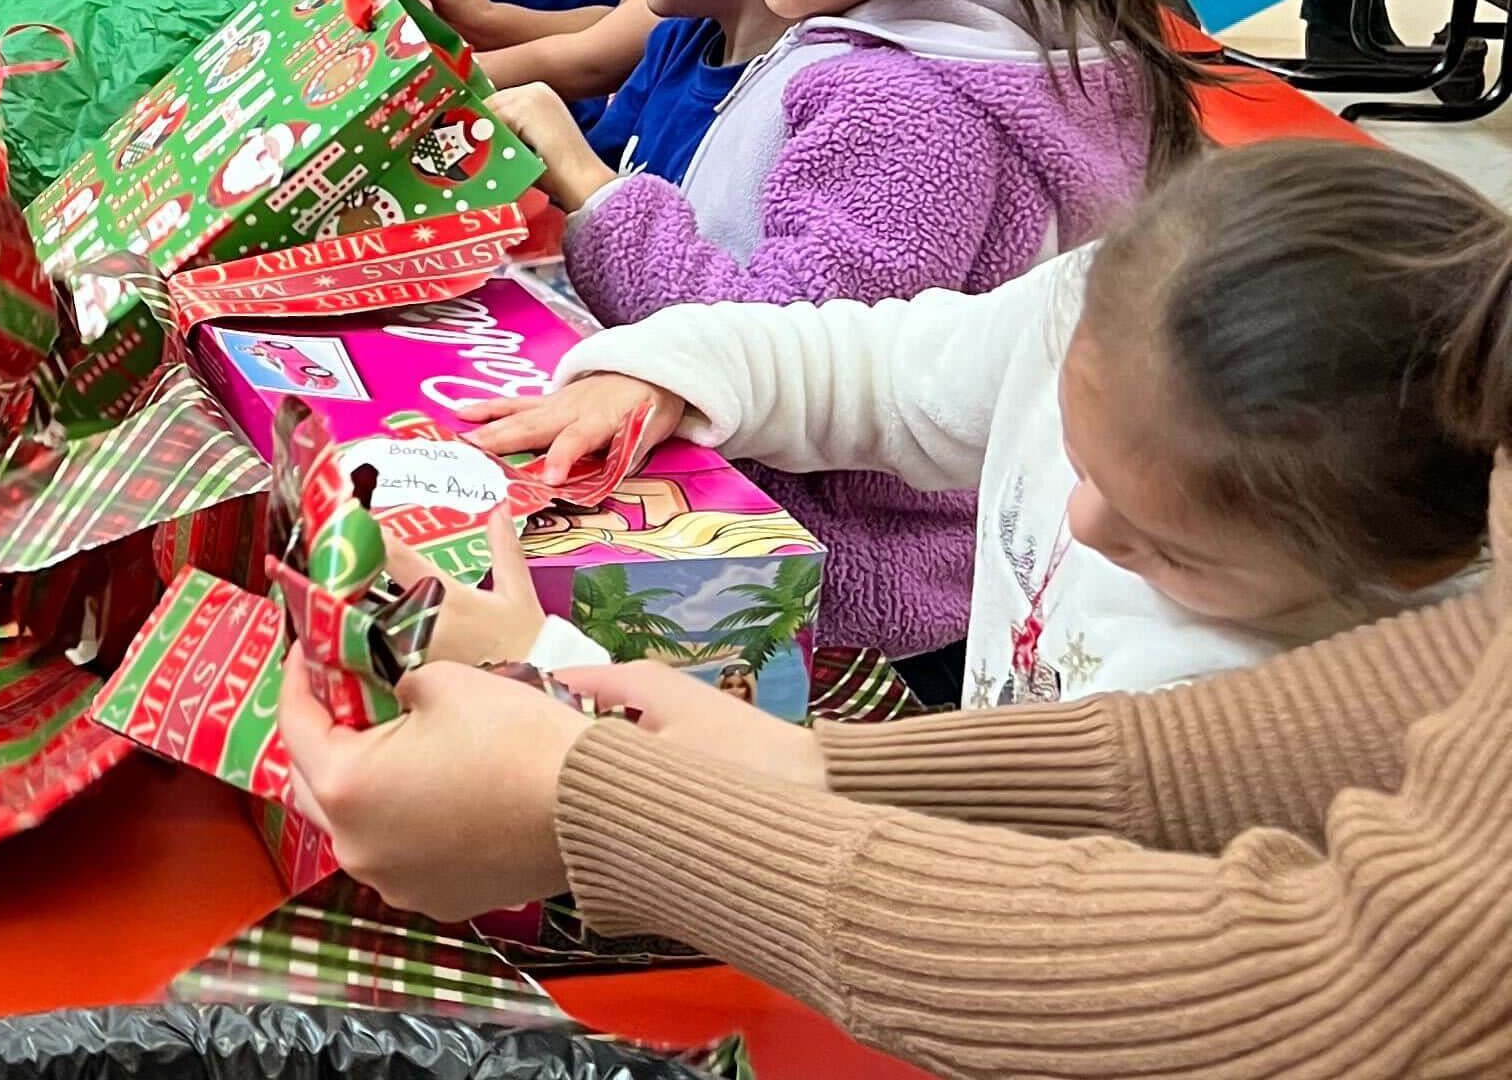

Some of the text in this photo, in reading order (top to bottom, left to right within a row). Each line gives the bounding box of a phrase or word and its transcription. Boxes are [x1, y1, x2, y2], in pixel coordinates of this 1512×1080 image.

[251, 231, 389, 277] MERRY
[315, 279, 451, 313] MERRY
[389, 443, 459, 461] Barajas
